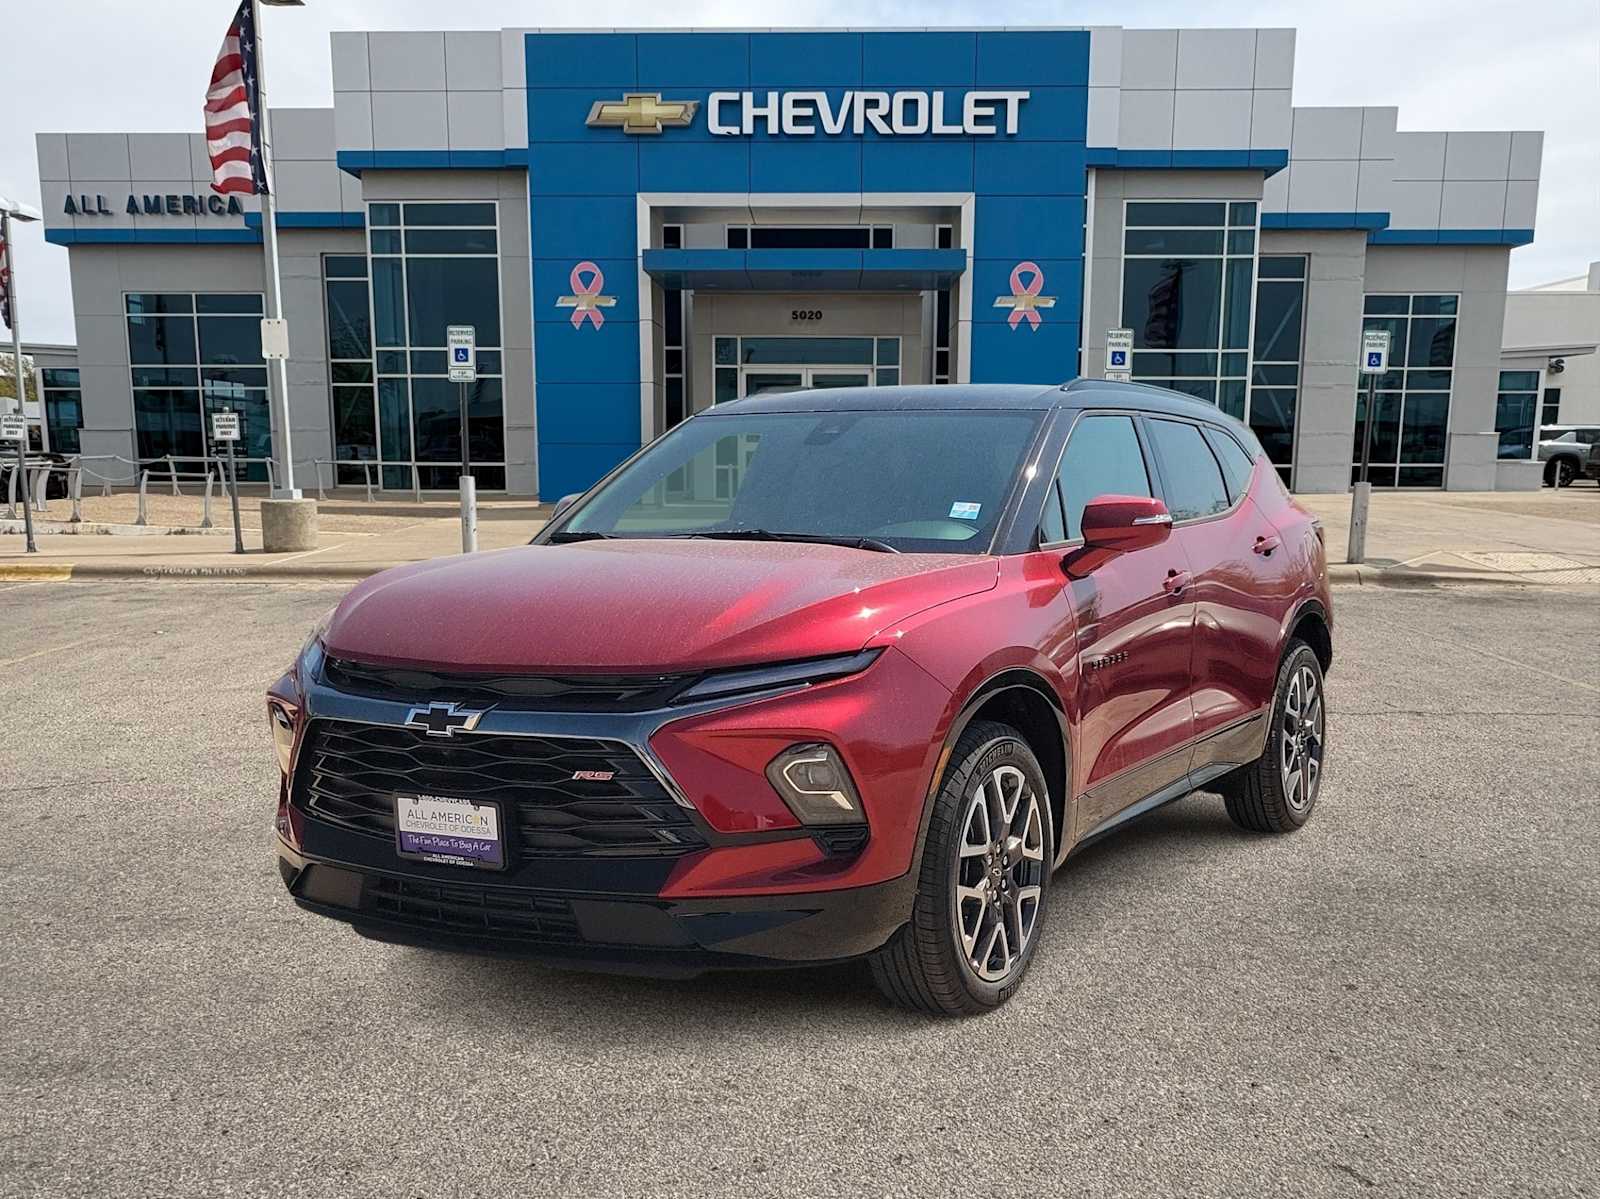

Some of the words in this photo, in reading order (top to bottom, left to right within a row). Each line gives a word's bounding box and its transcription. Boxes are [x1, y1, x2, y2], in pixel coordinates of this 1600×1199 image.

[707, 91, 1030, 135] CHEVROLET
[64, 195, 113, 215] ALL
[791, 310, 823, 320] 5020
[571, 770, 615, 781] RS
[407, 809, 427, 820] ALL
[405, 820, 448, 832] CHEVROLET
[449, 824, 459, 832] OF
[460, 825, 491, 835] ODESSA
[407, 834, 419, 845] The
[433, 836, 450, 848] Place
[450, 839, 459, 848] To
[459, 840, 473, 852] Buy
[472, 842, 480, 851] A
